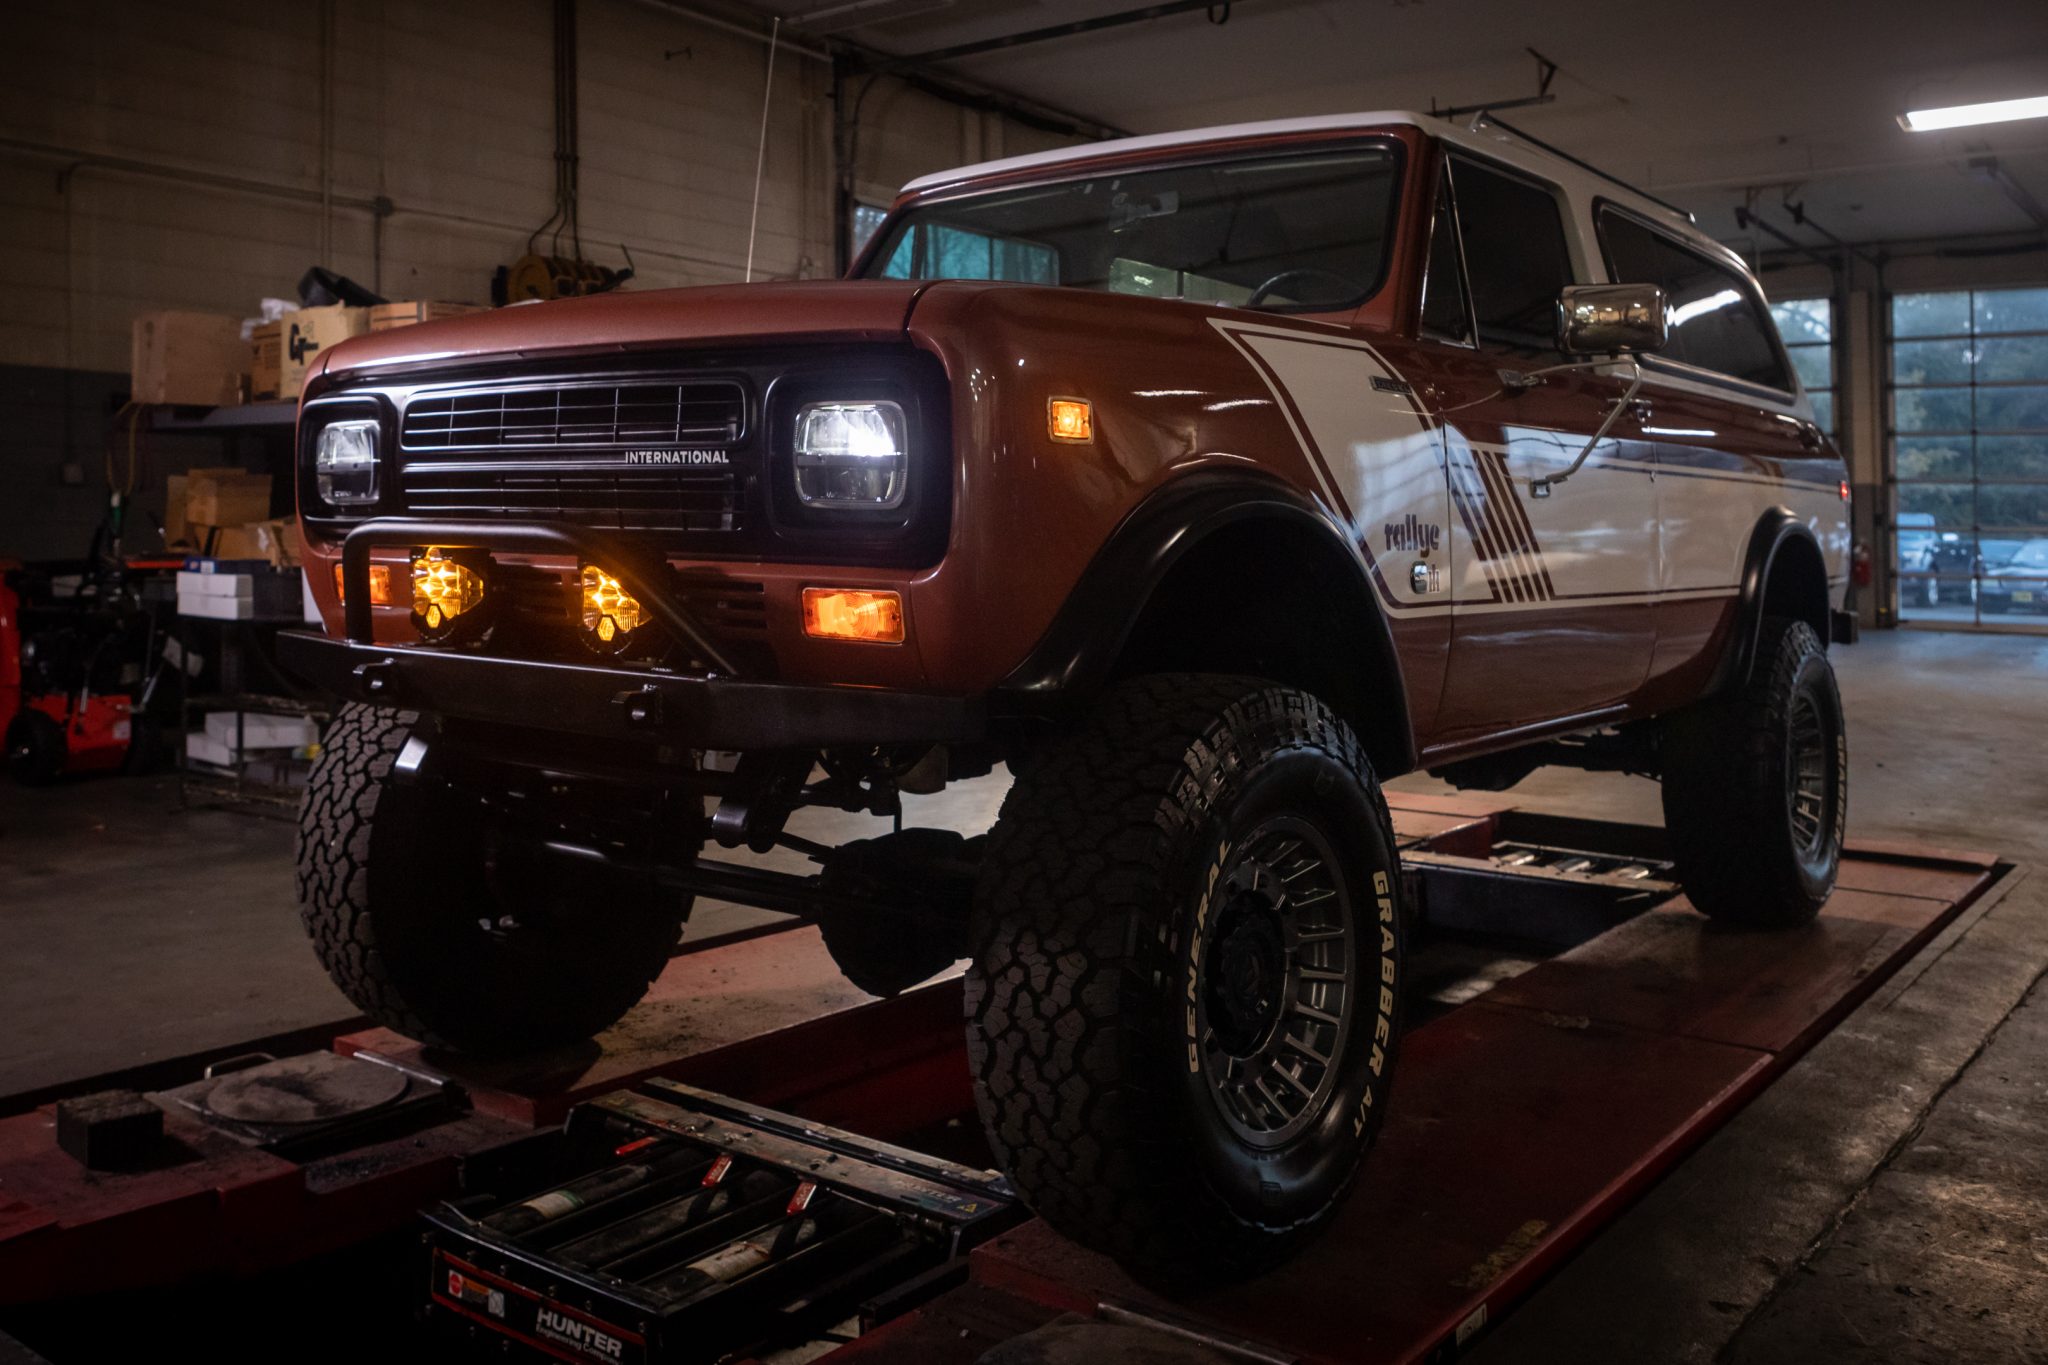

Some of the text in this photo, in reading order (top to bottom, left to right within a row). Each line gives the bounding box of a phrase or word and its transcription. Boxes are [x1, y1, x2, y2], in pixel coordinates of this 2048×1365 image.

[625, 450, 730, 464] INTERNATIONAL
[1384, 513, 1440, 558] rallye
[1184, 839, 1232, 1074] GENERAL
[1353, 870, 1396, 1139] GRABBER A/T
[536, 1306, 623, 1359] HUNTER
